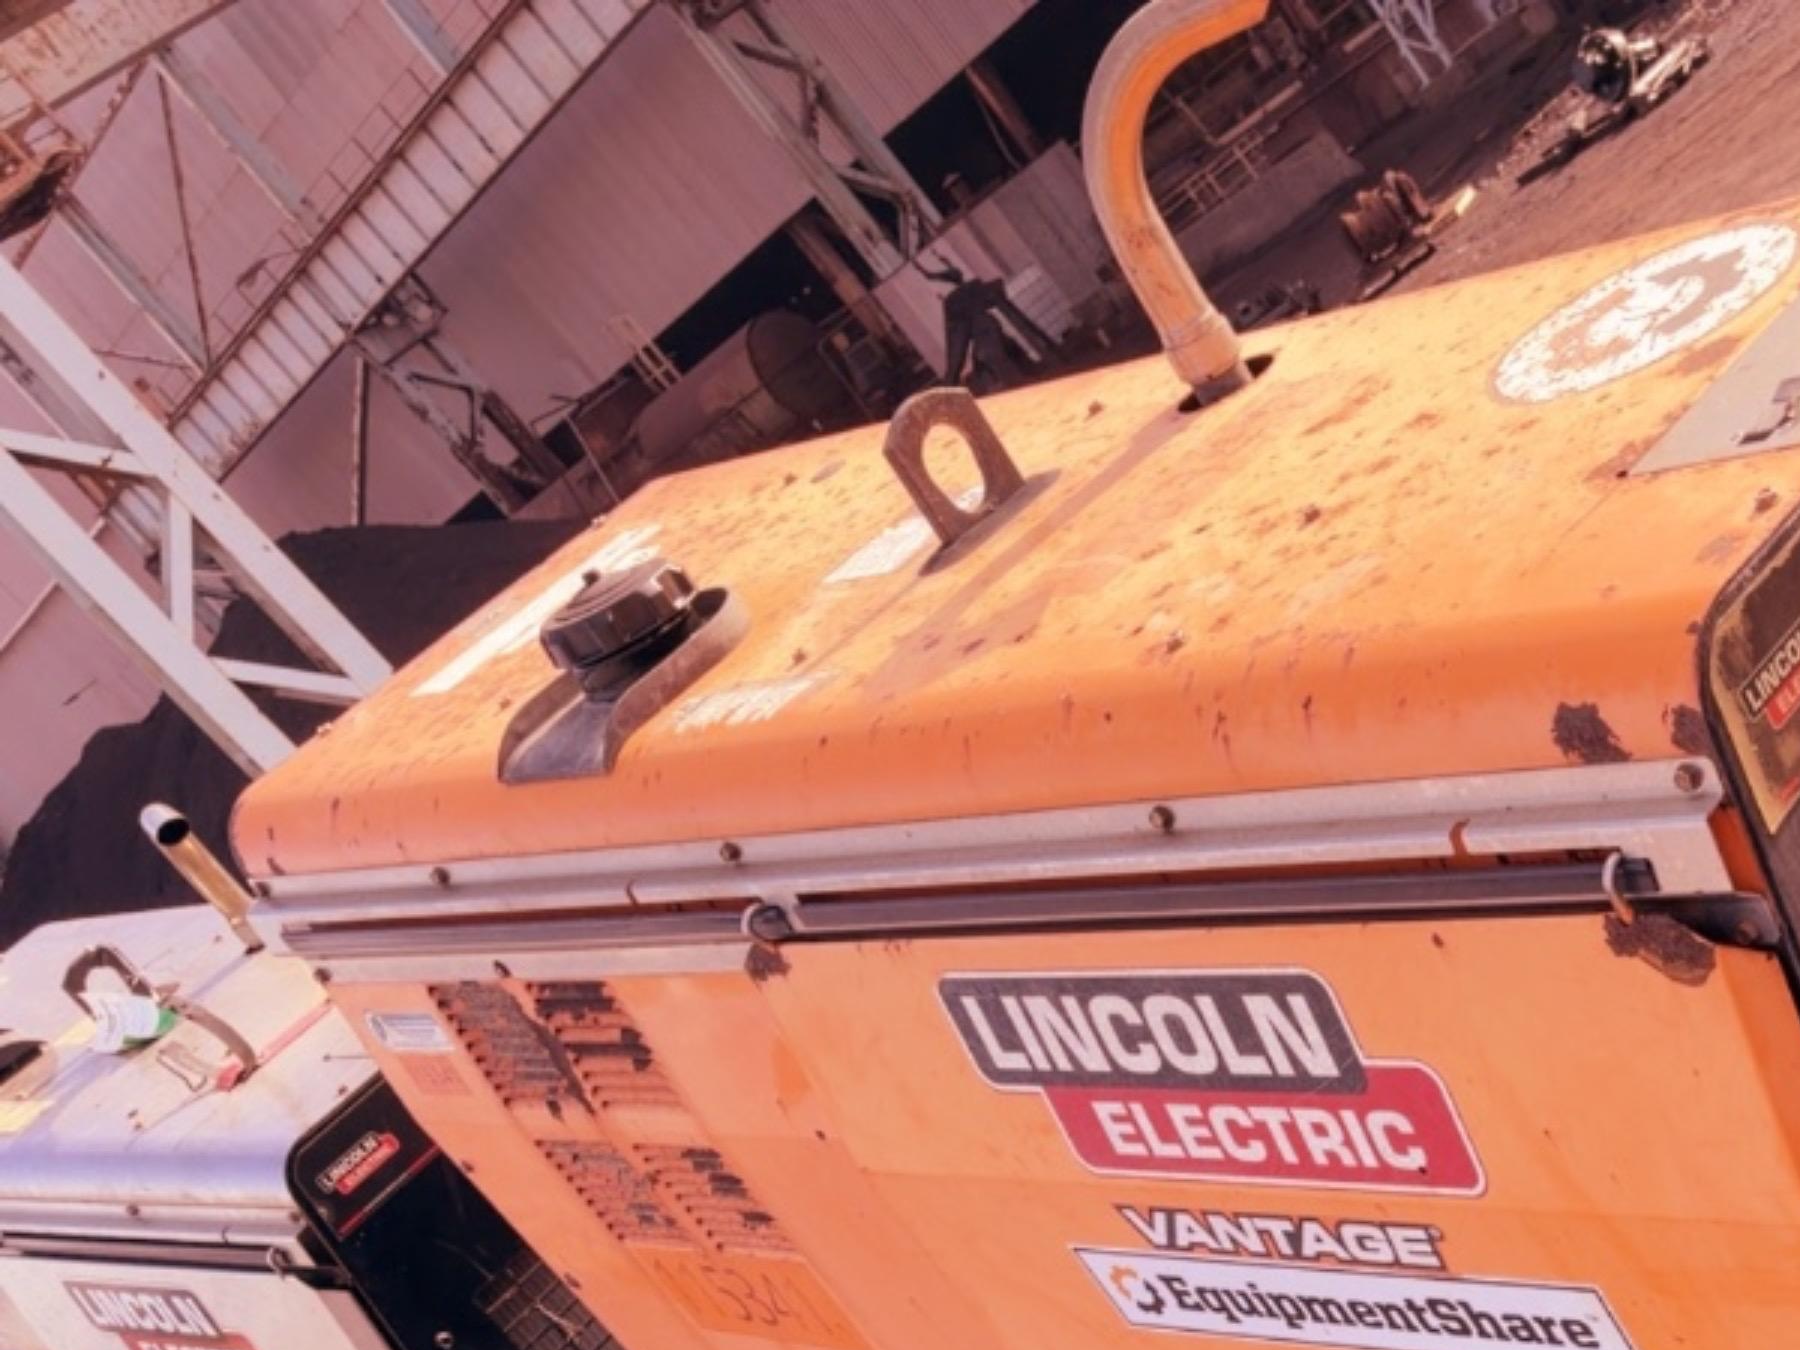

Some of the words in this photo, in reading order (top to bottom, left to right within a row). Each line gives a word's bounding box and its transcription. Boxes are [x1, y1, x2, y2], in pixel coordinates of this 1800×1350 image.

[962, 993, 1341, 1079] LINCOLN
[1091, 1100, 1427, 1171] ELECTRIC
[1122, 1206, 1444, 1268] VANTAGE
[71, 1286, 219, 1337] LINCOLN
[1168, 1274, 1602, 1350] EquipmentShare
